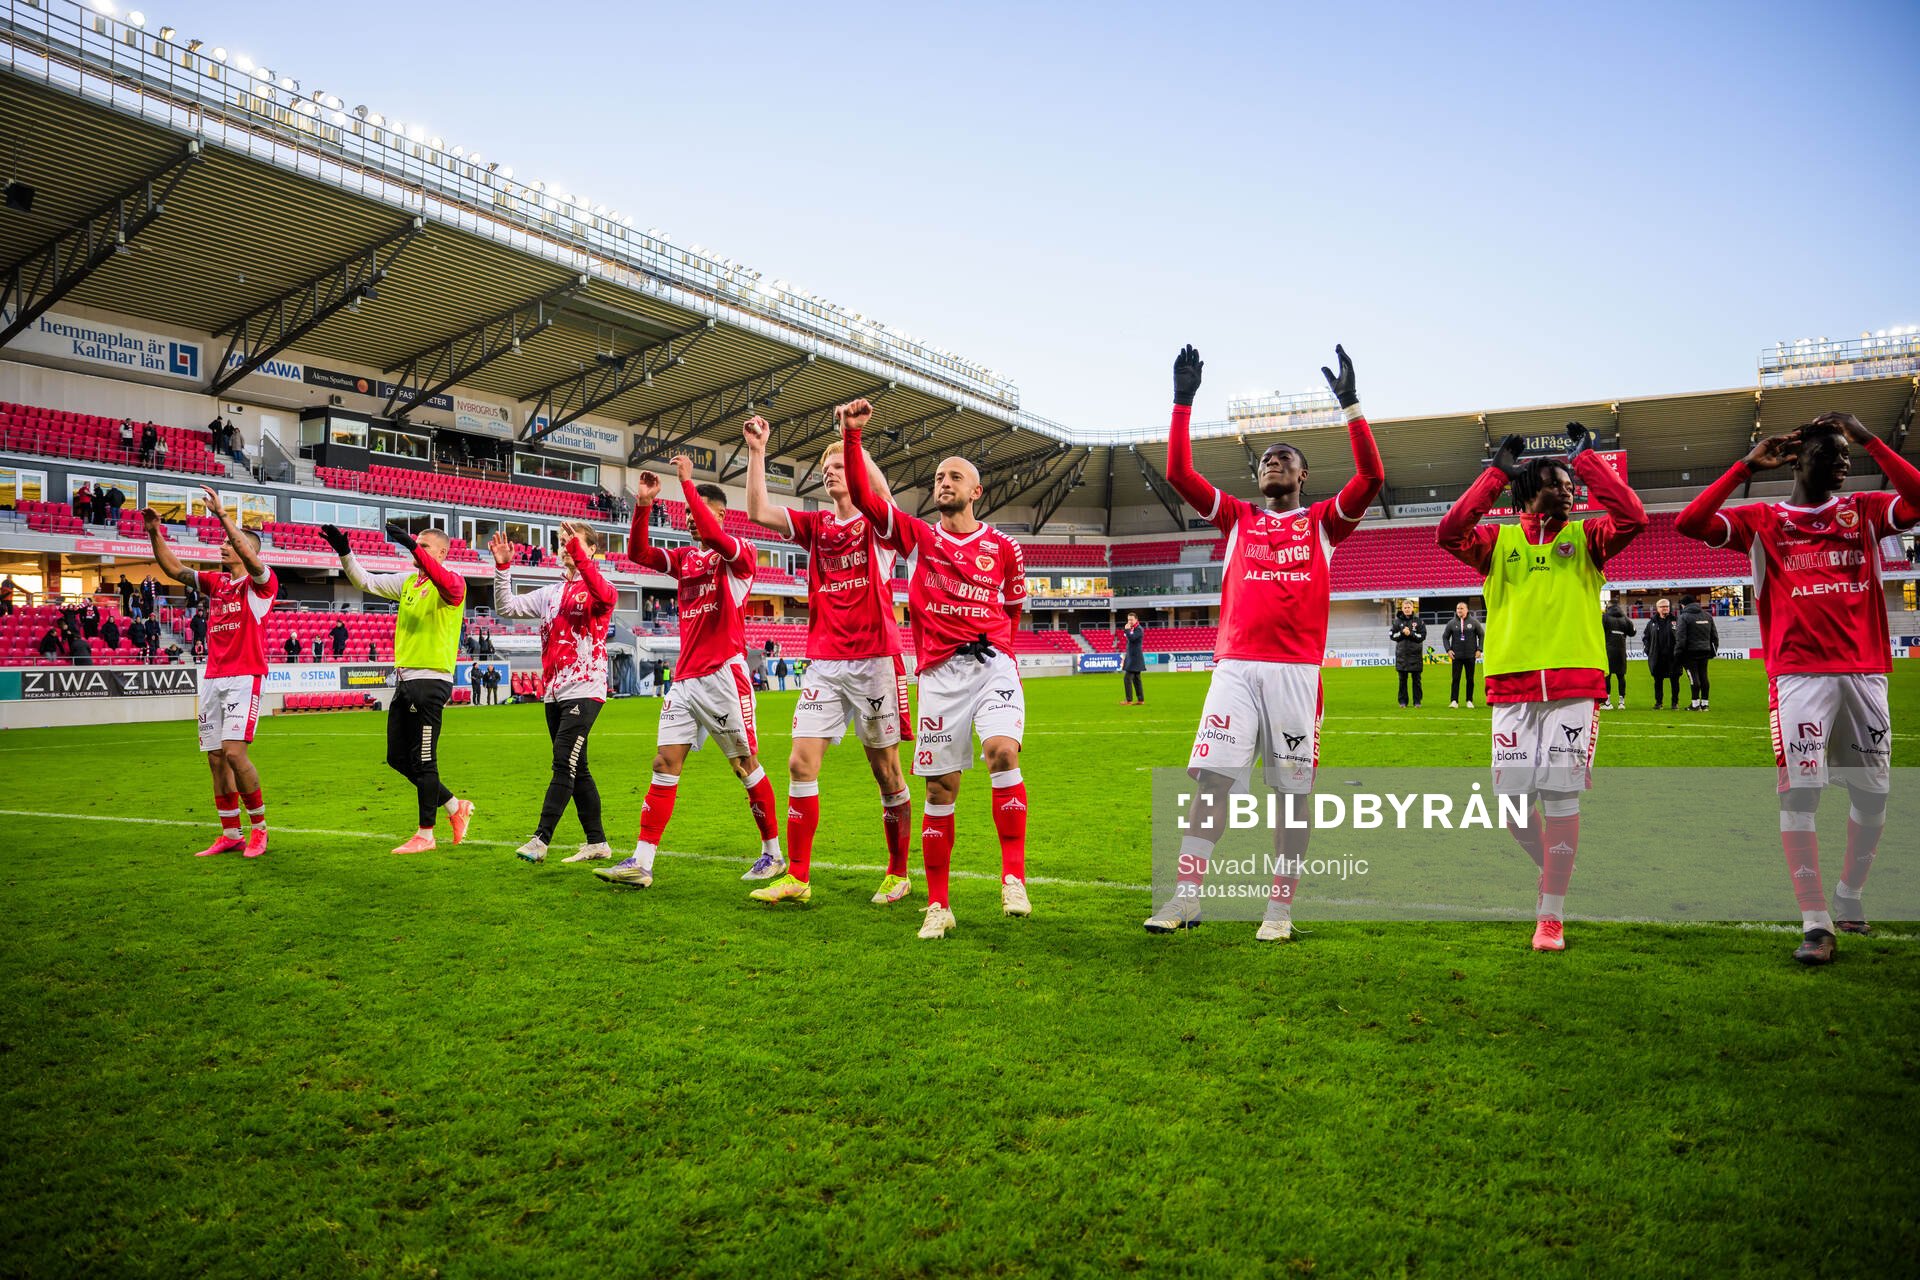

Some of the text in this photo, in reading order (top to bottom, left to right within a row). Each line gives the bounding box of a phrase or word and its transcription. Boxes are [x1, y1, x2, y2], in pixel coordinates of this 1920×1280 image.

[40, 316, 143, 351] hemmaplan
[148, 339, 165, 354] är
[73, 340, 165, 370] Kalmar län
[228, 353, 301, 380] YAKAWA
[551, 433, 596, 451] Kalmar län
[557, 423, 619, 444] nsförsäkringar
[1526, 435, 1574, 450] ldFåge
[1243, 569, 1311, 581] ALEMTEK
[818, 576, 870, 593] ALEMTEK
[925, 571, 990, 602] MULTIBYGG
[1791, 579, 1870, 598] ALEMTEK
[925, 602, 990, 618] ALEMTEK
[1355, 658, 1395, 666] TREBOLI
[24, 672, 108, 691] ZIWA
[123, 670, 195, 690] ZIWA
[267, 670, 336, 680] TENA STENA
[919, 733, 953, 747] ybloms
[1790, 739, 1825, 754] Nyblo
[918, 750, 933, 765] 23
[1193, 743, 1209, 757] 70
[1497, 751, 1528, 762] bloms
[1799, 759, 1818, 776] 20
